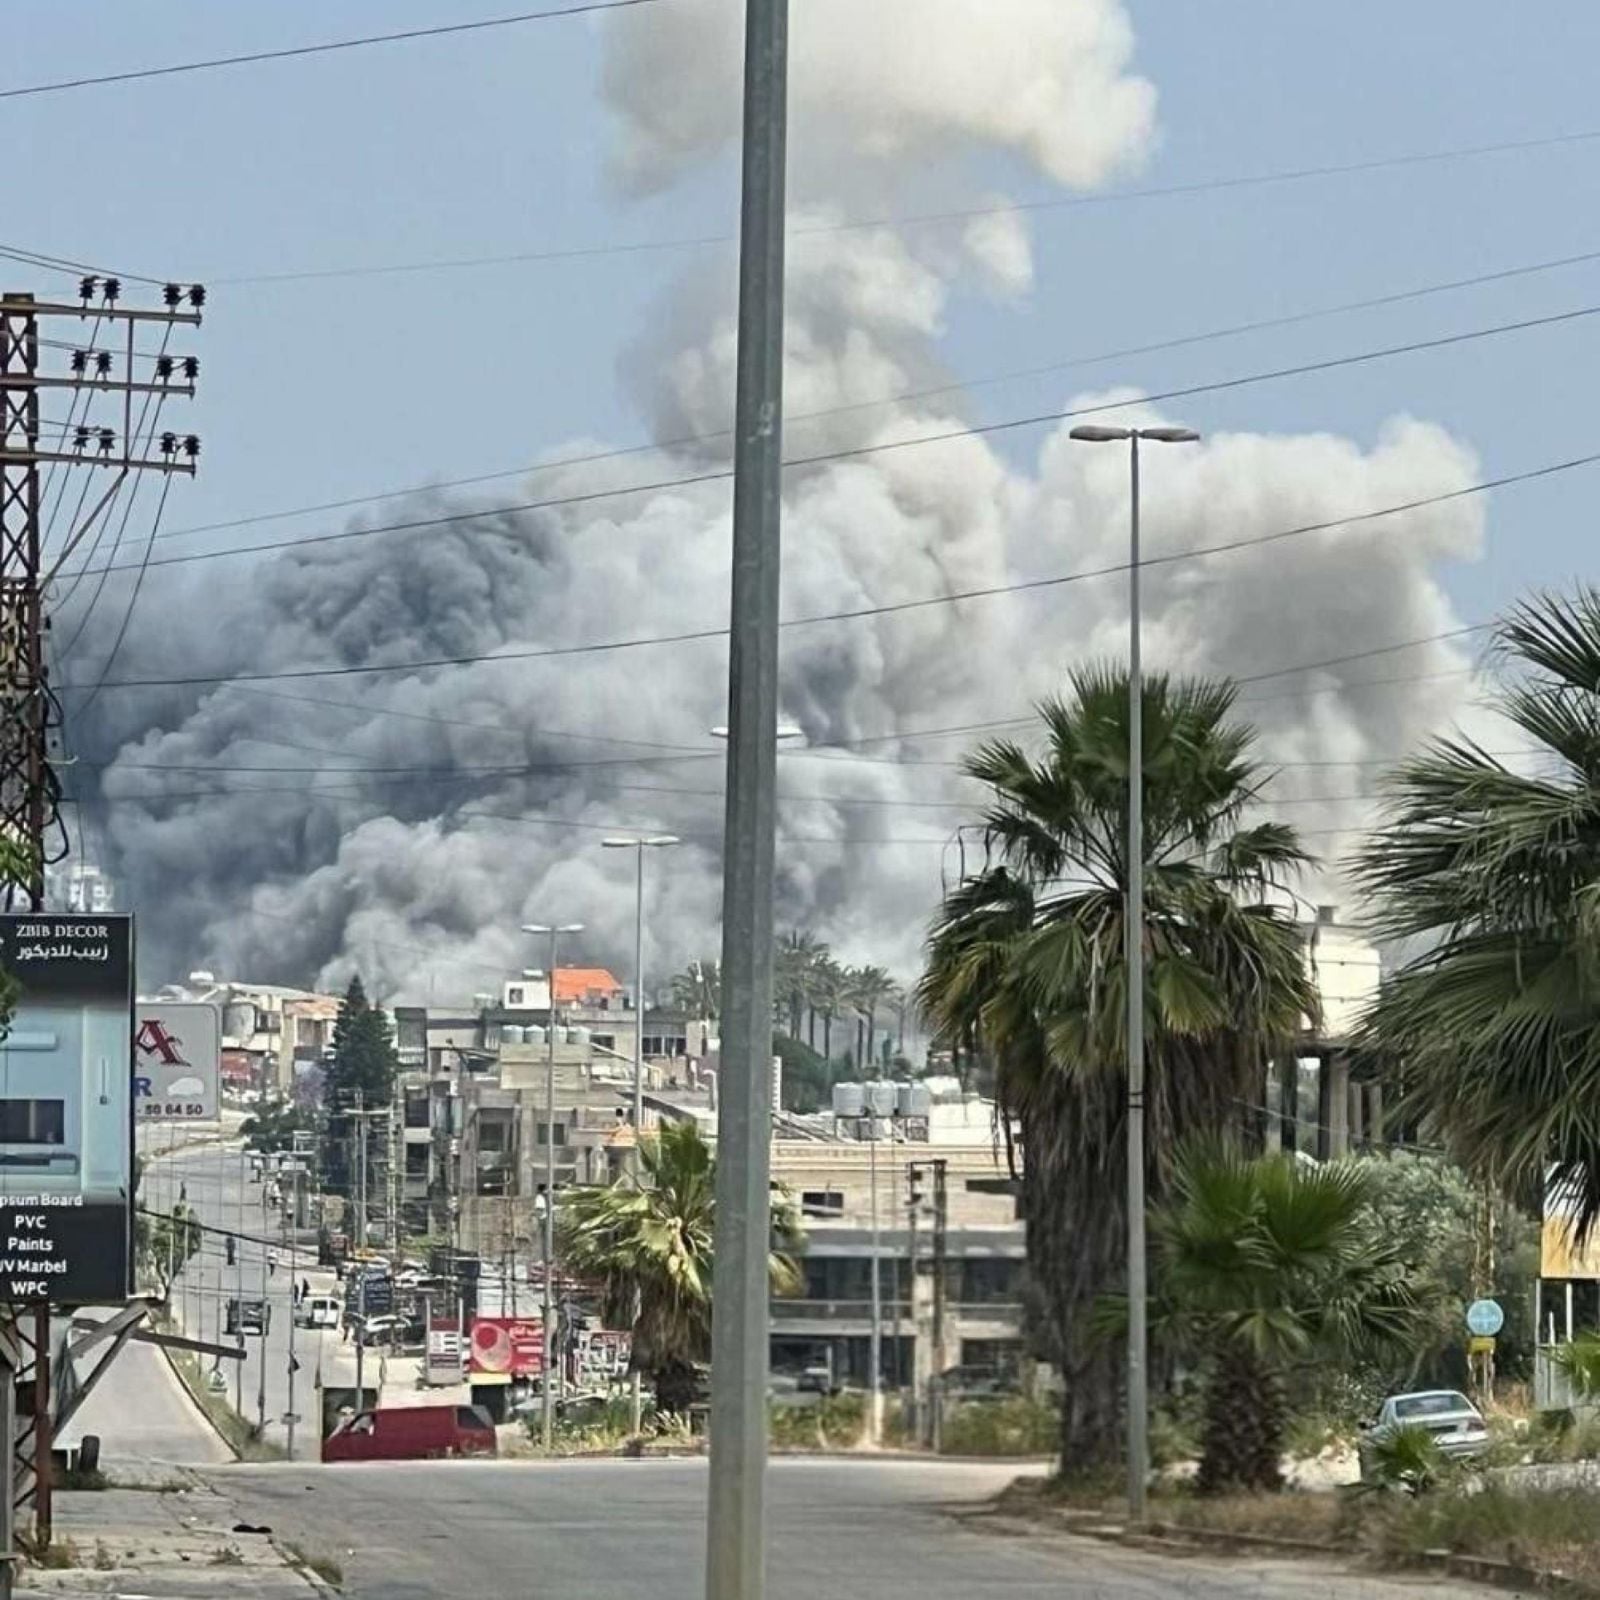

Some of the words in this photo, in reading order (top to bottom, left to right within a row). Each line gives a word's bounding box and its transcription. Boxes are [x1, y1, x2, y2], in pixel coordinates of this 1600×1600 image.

[16, 924, 50, 938] ZBIB
[54, 924, 108, 938] DECOR
[40, 1192, 83, 1206] Board
[14, 1214, 47, 1229] PVC
[7, 1237, 53, 1251] Paints
[17, 1259, 67, 1273] Marbel
[11, 1281, 48, 1295] WPC
